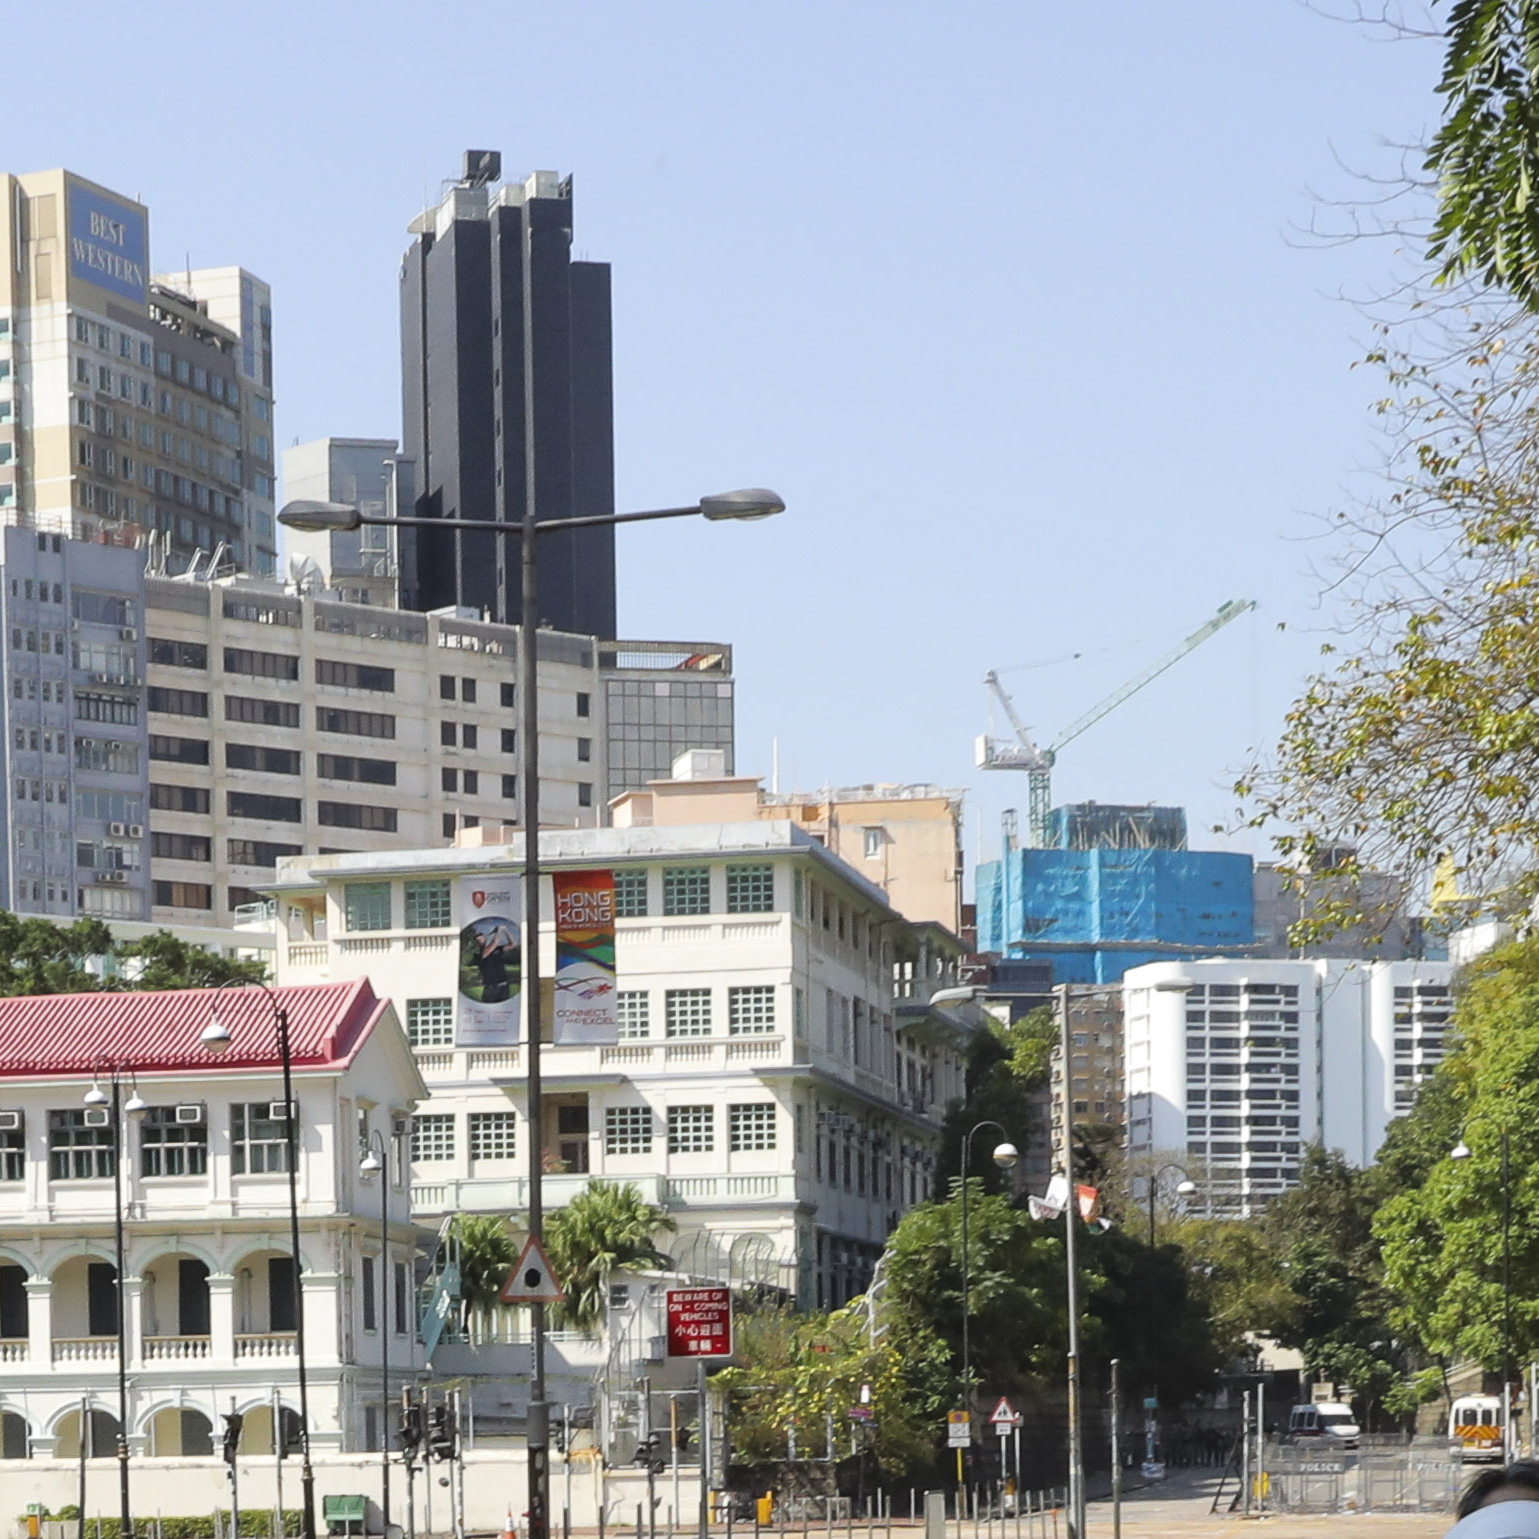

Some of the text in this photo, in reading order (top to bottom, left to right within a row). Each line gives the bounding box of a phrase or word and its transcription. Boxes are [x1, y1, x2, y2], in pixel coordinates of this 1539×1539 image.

[90, 210, 127, 247] BEST
[73, 236, 144, 287] WESTERN
[558, 891, 611, 908] HONG
[558, 907, 612, 923] KONG
[672, 1292, 723, 1302] BEWARE OF
[669, 1304, 682, 1312] ON
[694, 1302, 729, 1311] COMING
[679, 1311, 719, 1321] VEHICLES
[1299, 1461, 1342, 1472] POLICE
[1416, 1461, 1460, 1472] POLICE
